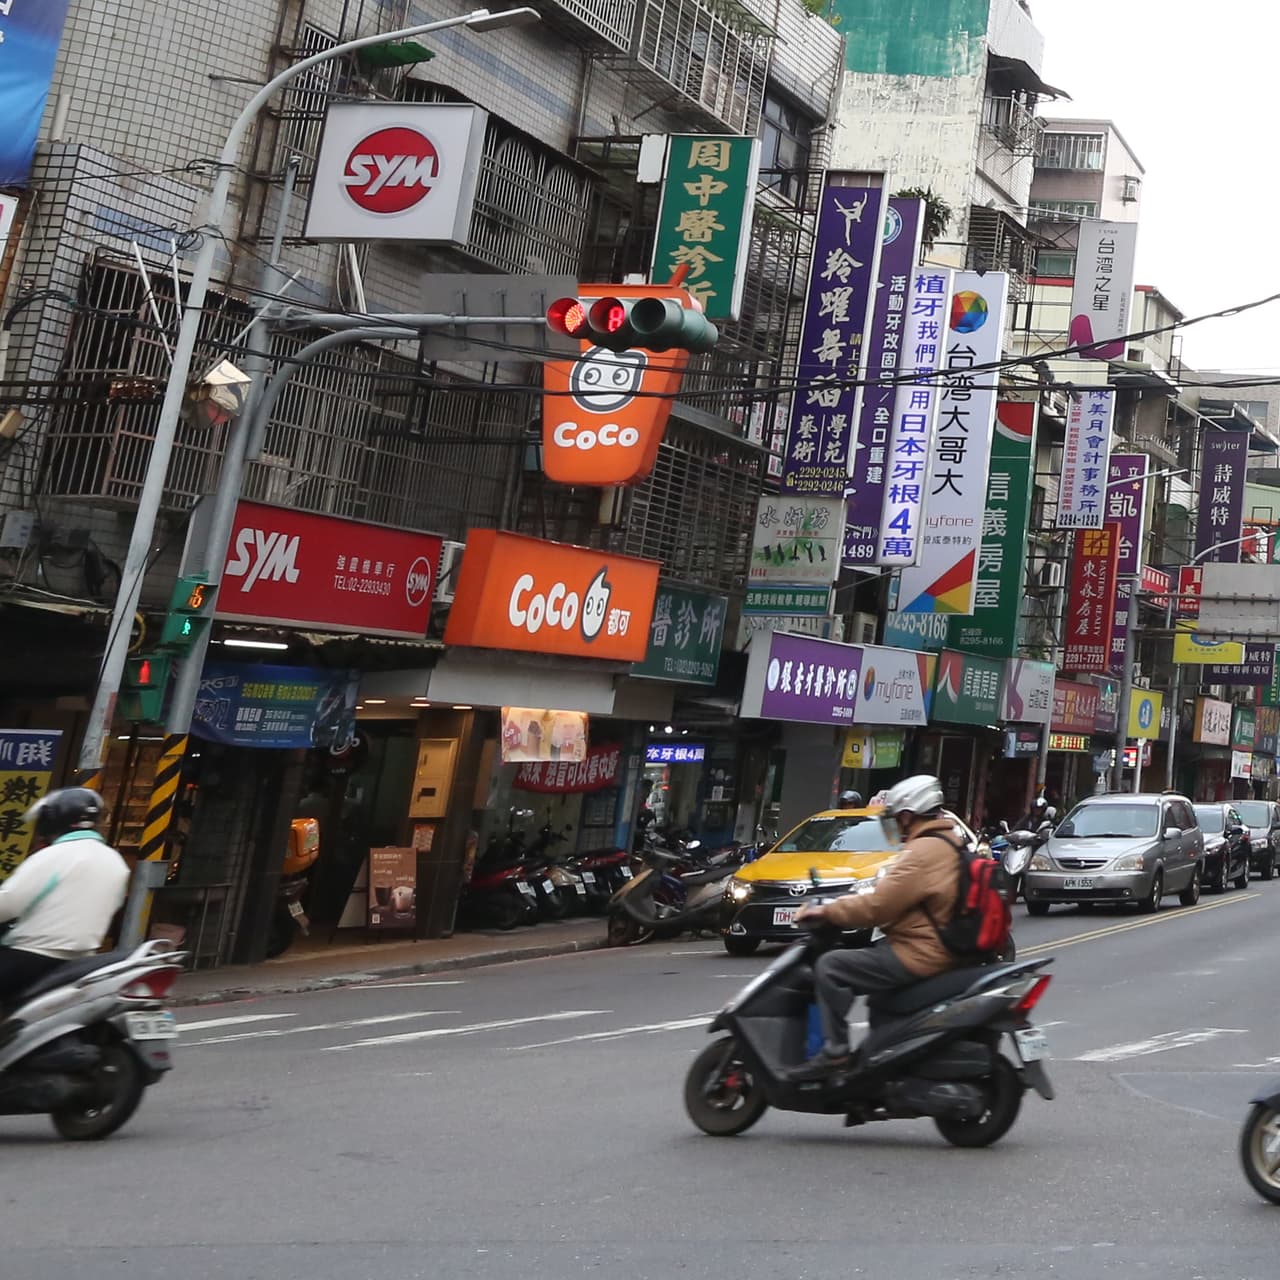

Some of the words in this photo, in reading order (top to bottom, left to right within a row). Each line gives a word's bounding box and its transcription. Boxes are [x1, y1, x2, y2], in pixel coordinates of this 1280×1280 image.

[344, 153, 440, 195] SYM
[553, 422, 640, 451] CoCo
[1210, 464, 1233, 526] 詩威特
[225, 527, 300, 593] SYM
[508, 573, 579, 634] CoCo
[607, 607, 632, 637] 都可
[1075, 560, 1097, 635] 東森房屋
